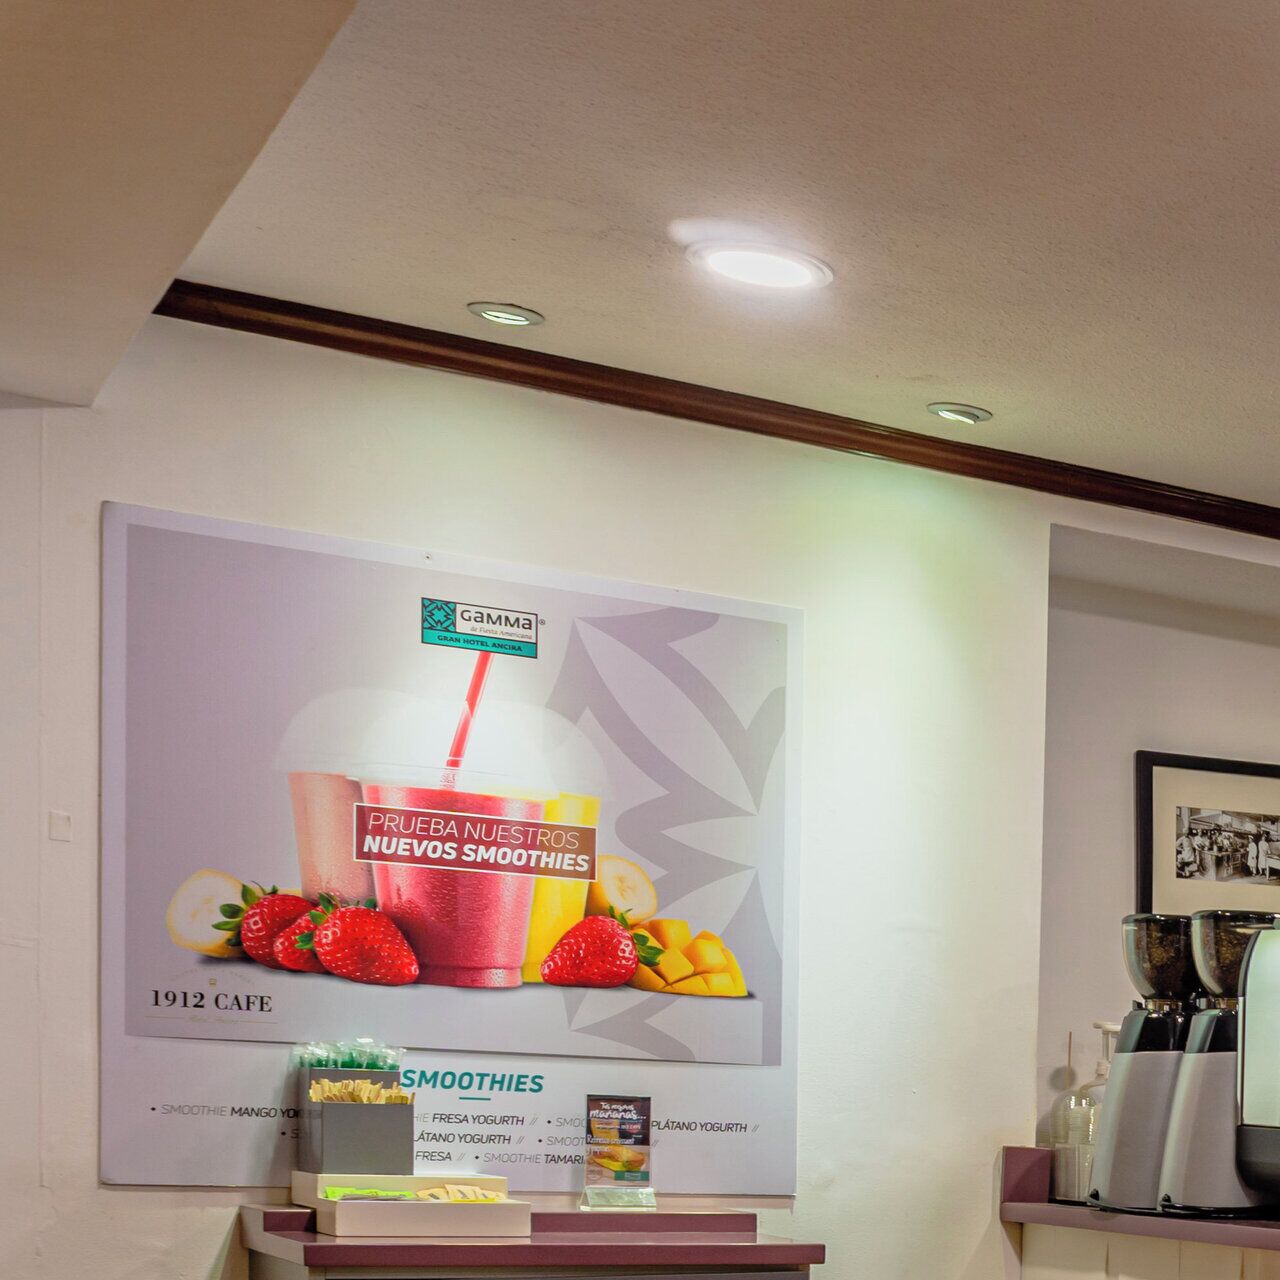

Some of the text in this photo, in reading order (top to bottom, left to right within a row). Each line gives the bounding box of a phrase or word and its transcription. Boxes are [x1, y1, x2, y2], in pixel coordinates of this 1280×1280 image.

[438, 635, 522, 651] GRAN HOTEL ANCIRA
[369, 813, 579, 849] PRUEBA NUESTROS
[363, 835, 590, 872] NUEVOS SMOOTHIES
[152, 990, 272, 1012] 1912 CAFE
[401, 1069, 544, 1093] SMOOTHIES
[161, 1104, 277, 1118] SMOOTHIE MANGO
[433, 1114, 468, 1123] FRESA
[472, 1115, 524, 1125] YOGURTH
[652, 1119, 697, 1131] PLÁTANO
[699, 1122, 747, 1133] YOGURTH
[458, 1134, 511, 1144] YOGURTH
[416, 1151, 451, 1161] FRESA
[484, 1153, 541, 1163] SMOOTHIE
